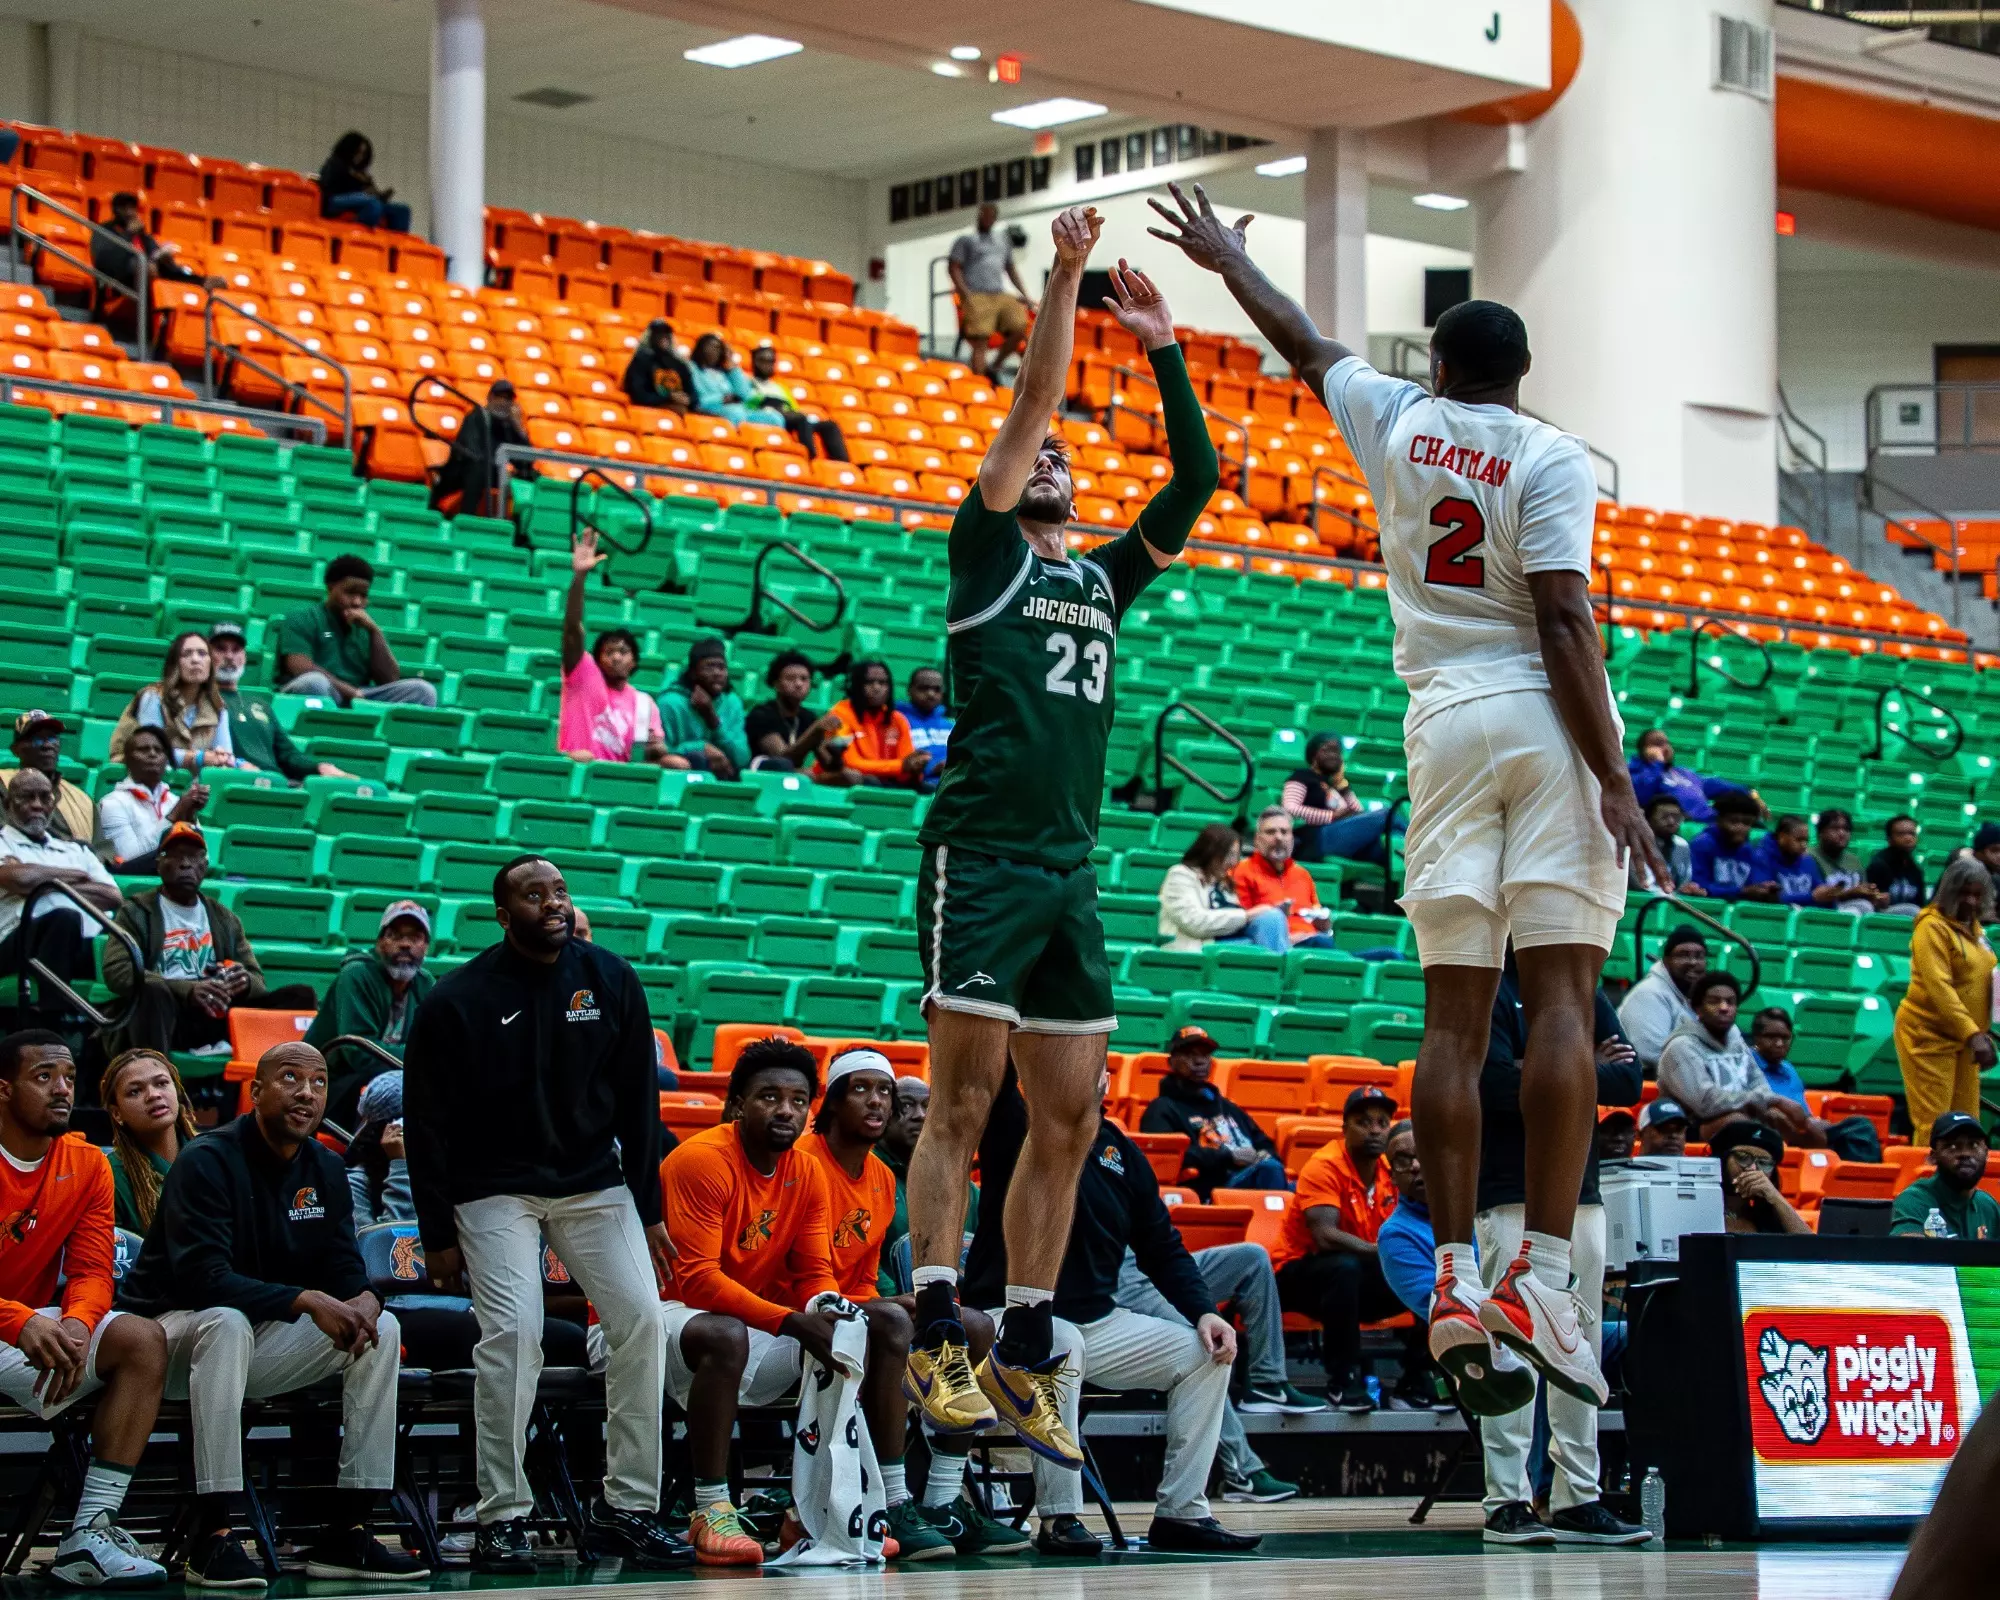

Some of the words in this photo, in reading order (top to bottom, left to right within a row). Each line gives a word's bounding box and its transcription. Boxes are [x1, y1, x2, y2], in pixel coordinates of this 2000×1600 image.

[1484, 11, 1501, 44] J
[1409, 434, 1512, 488] CHATMAN
[1424, 495, 1485, 588] 2
[1046, 631, 1108, 705] 23
[565, 1008, 602, 1018] RATTLERS
[288, 1206, 326, 1217] RATTLERS
[1834, 1334, 1937, 1392] piggly
